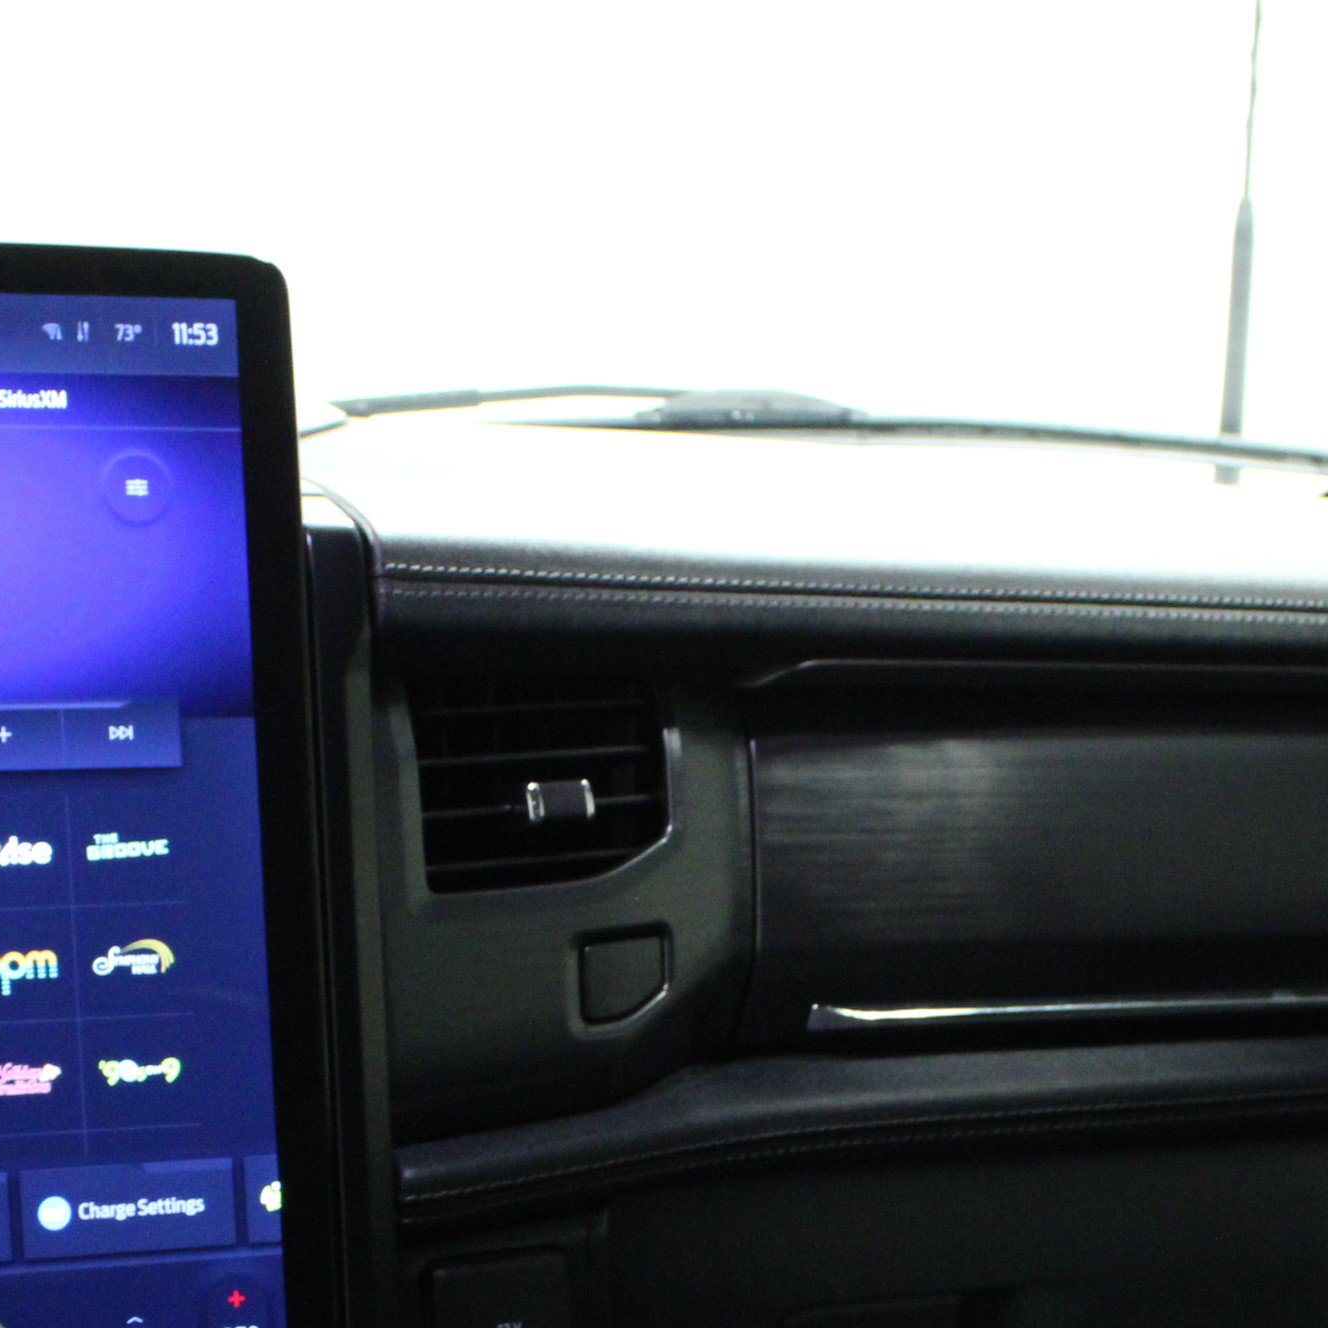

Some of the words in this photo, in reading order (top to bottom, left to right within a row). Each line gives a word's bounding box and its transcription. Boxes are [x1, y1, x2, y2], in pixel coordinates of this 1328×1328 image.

[172, 322, 220, 346] 11:53
[85, 838, 170, 861] GROOVE
[77, 1200, 137, 1222] Charge
[137, 1195, 205, 1217] Settings
